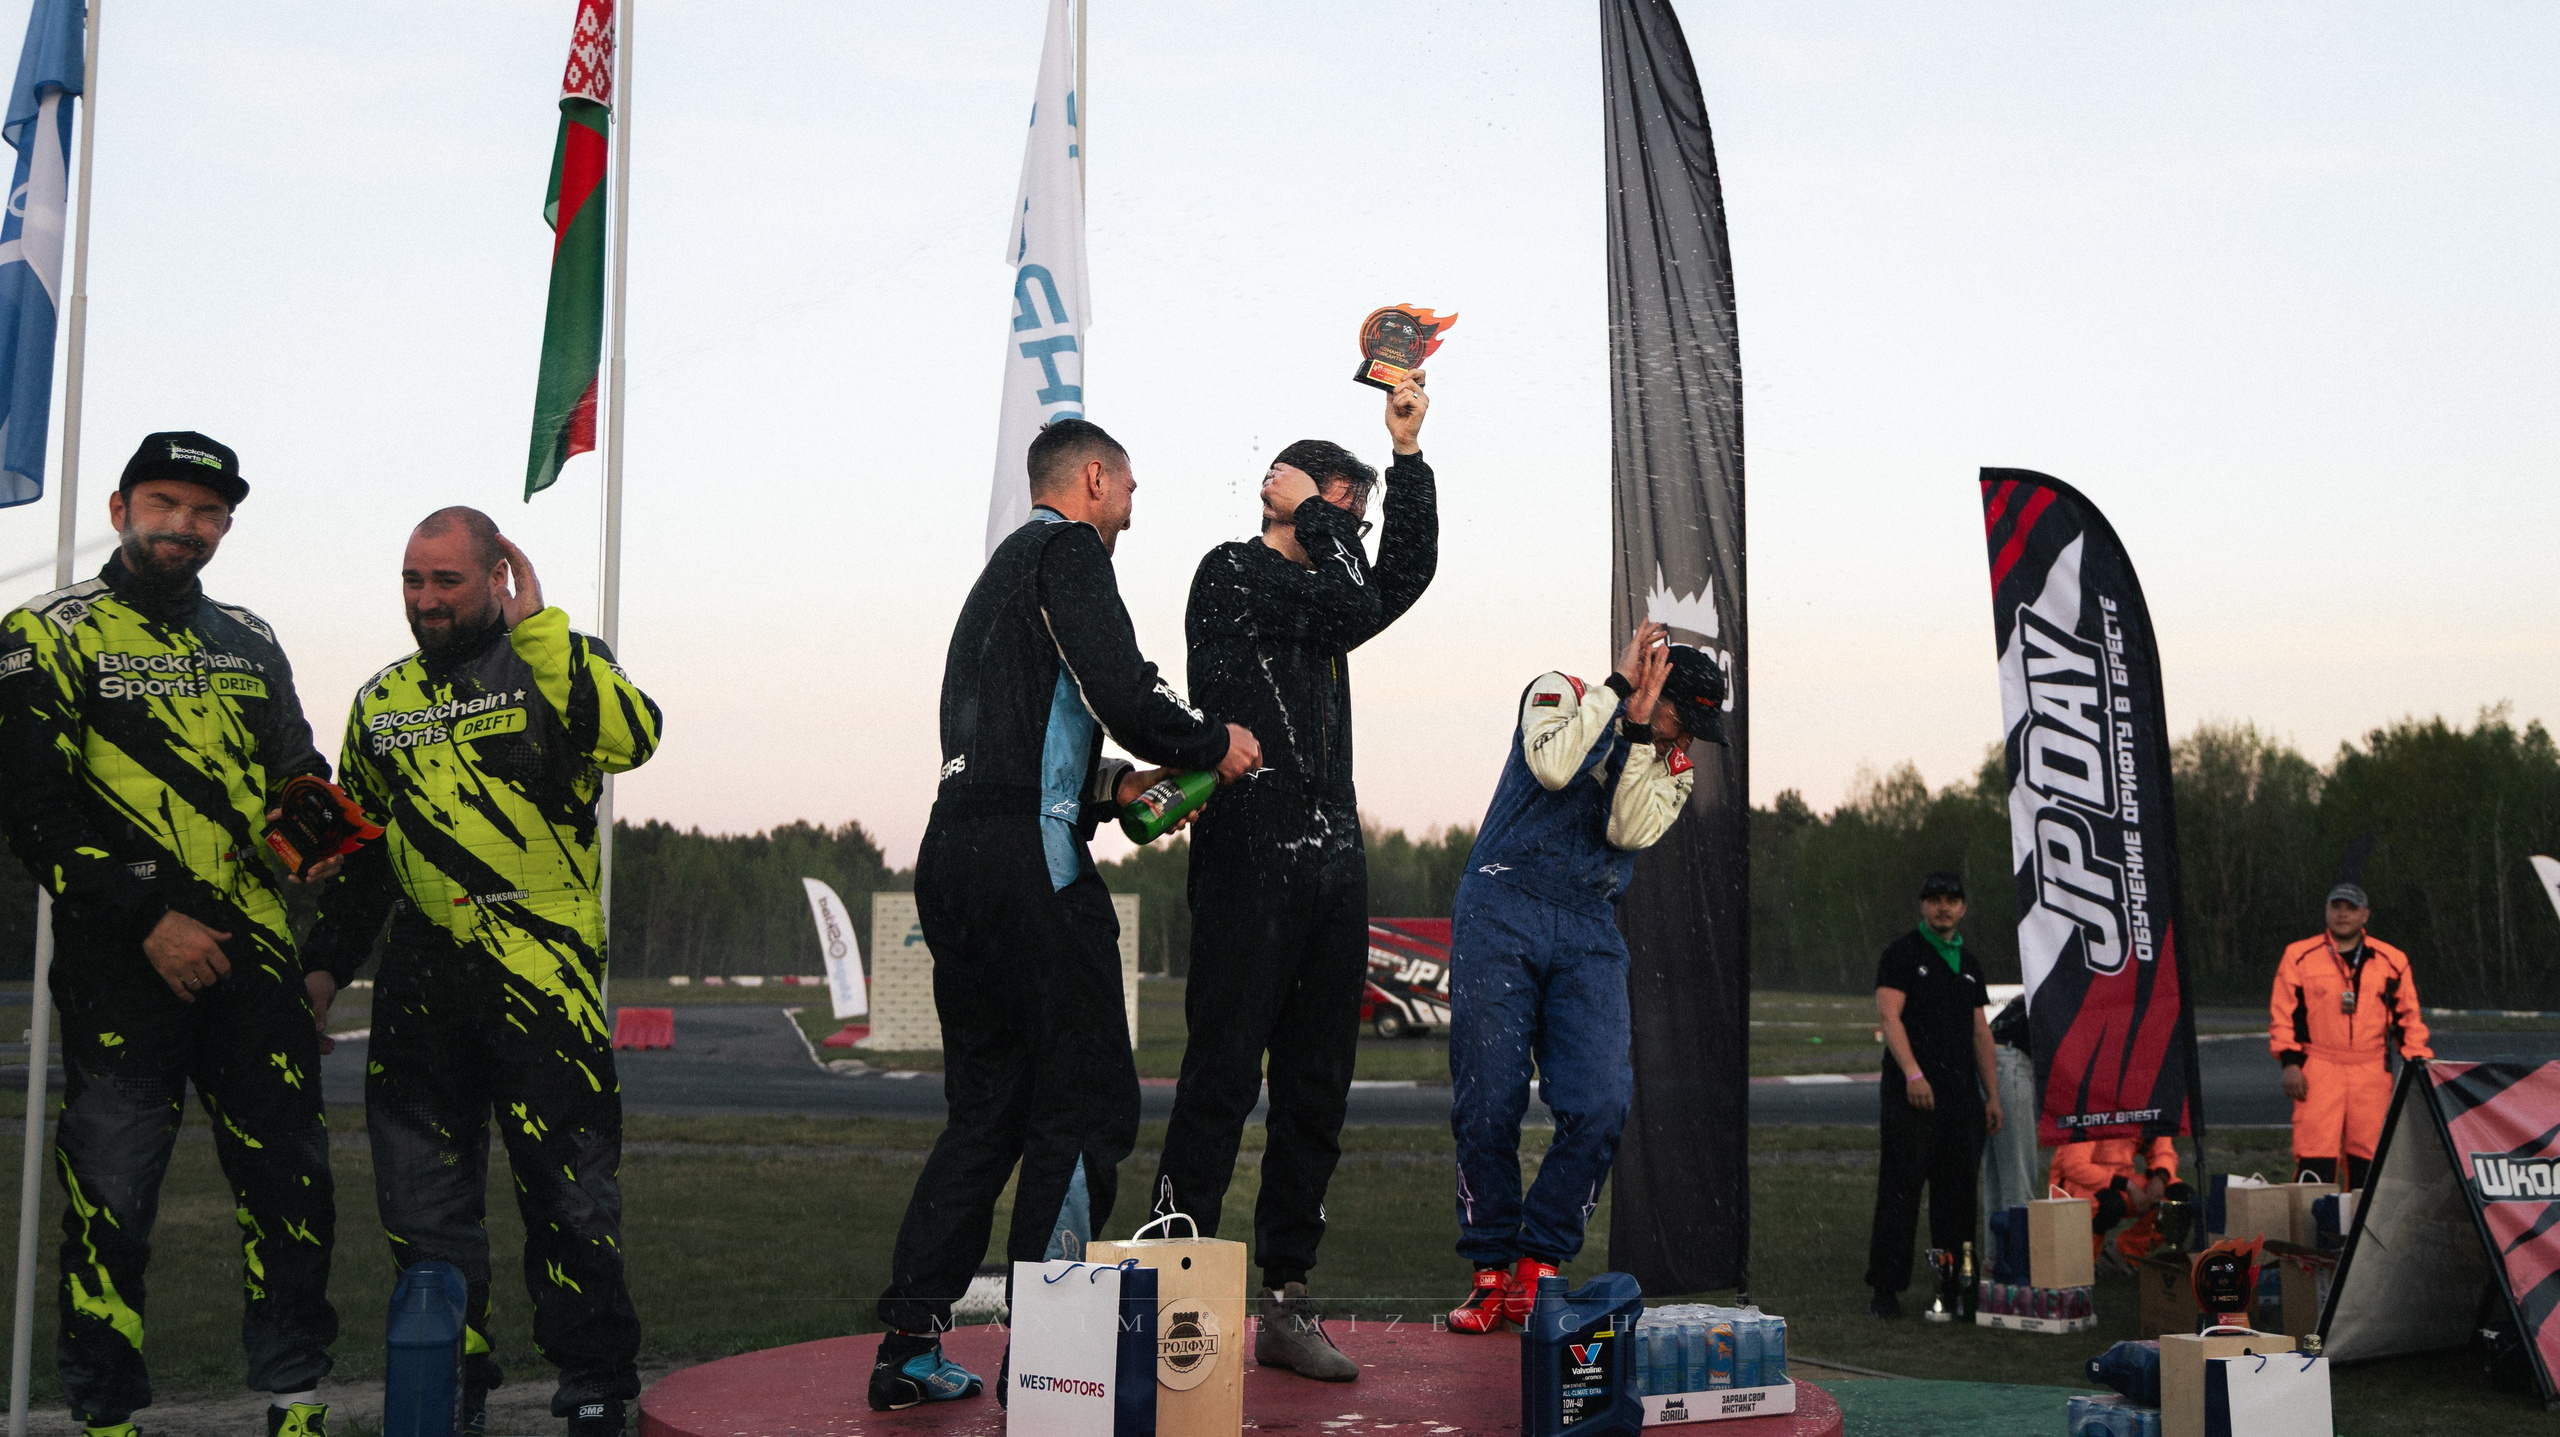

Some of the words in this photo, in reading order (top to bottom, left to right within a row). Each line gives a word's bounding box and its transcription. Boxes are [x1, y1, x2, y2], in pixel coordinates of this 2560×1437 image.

[171, 452, 202, 462] Sports
[2098, 595, 2129, 686] БРЕСТЕ
[99, 652, 252, 673] Blockchain
[99, 676, 209, 701] Sports
[219, 677, 261, 694] DRIFT
[369, 691, 508, 734] Blockchain
[2114, 696, 2132, 713] В
[372, 725, 448, 757] Sports
[462, 712, 516, 738] DRIFT
[2116, 721, 2139, 824] ДРИФТУ
[476, 895, 485, 904] R.
[485, 890, 529, 903] SAKSONOV
[2122, 830, 2153, 961] ОБУЧЕНИЕ
[1394, 959, 1439, 985] JP
[1571, 1366, 1603, 1375] Valvoline
[1019, 1373, 1105, 1398] WESTMOTORS
[1562, 1397, 1584, 1409] 10W-40
[1721, 1394, 1748, 1404] ЗАРЯДИ
[1748, 1392, 1766, 1403] СВОЙ
[579, 1406, 604, 1416] OMP
[1660, 1409, 1689, 1422] GORILLA
[1721, 1403, 1757, 1414] ИНСТИНКТ
